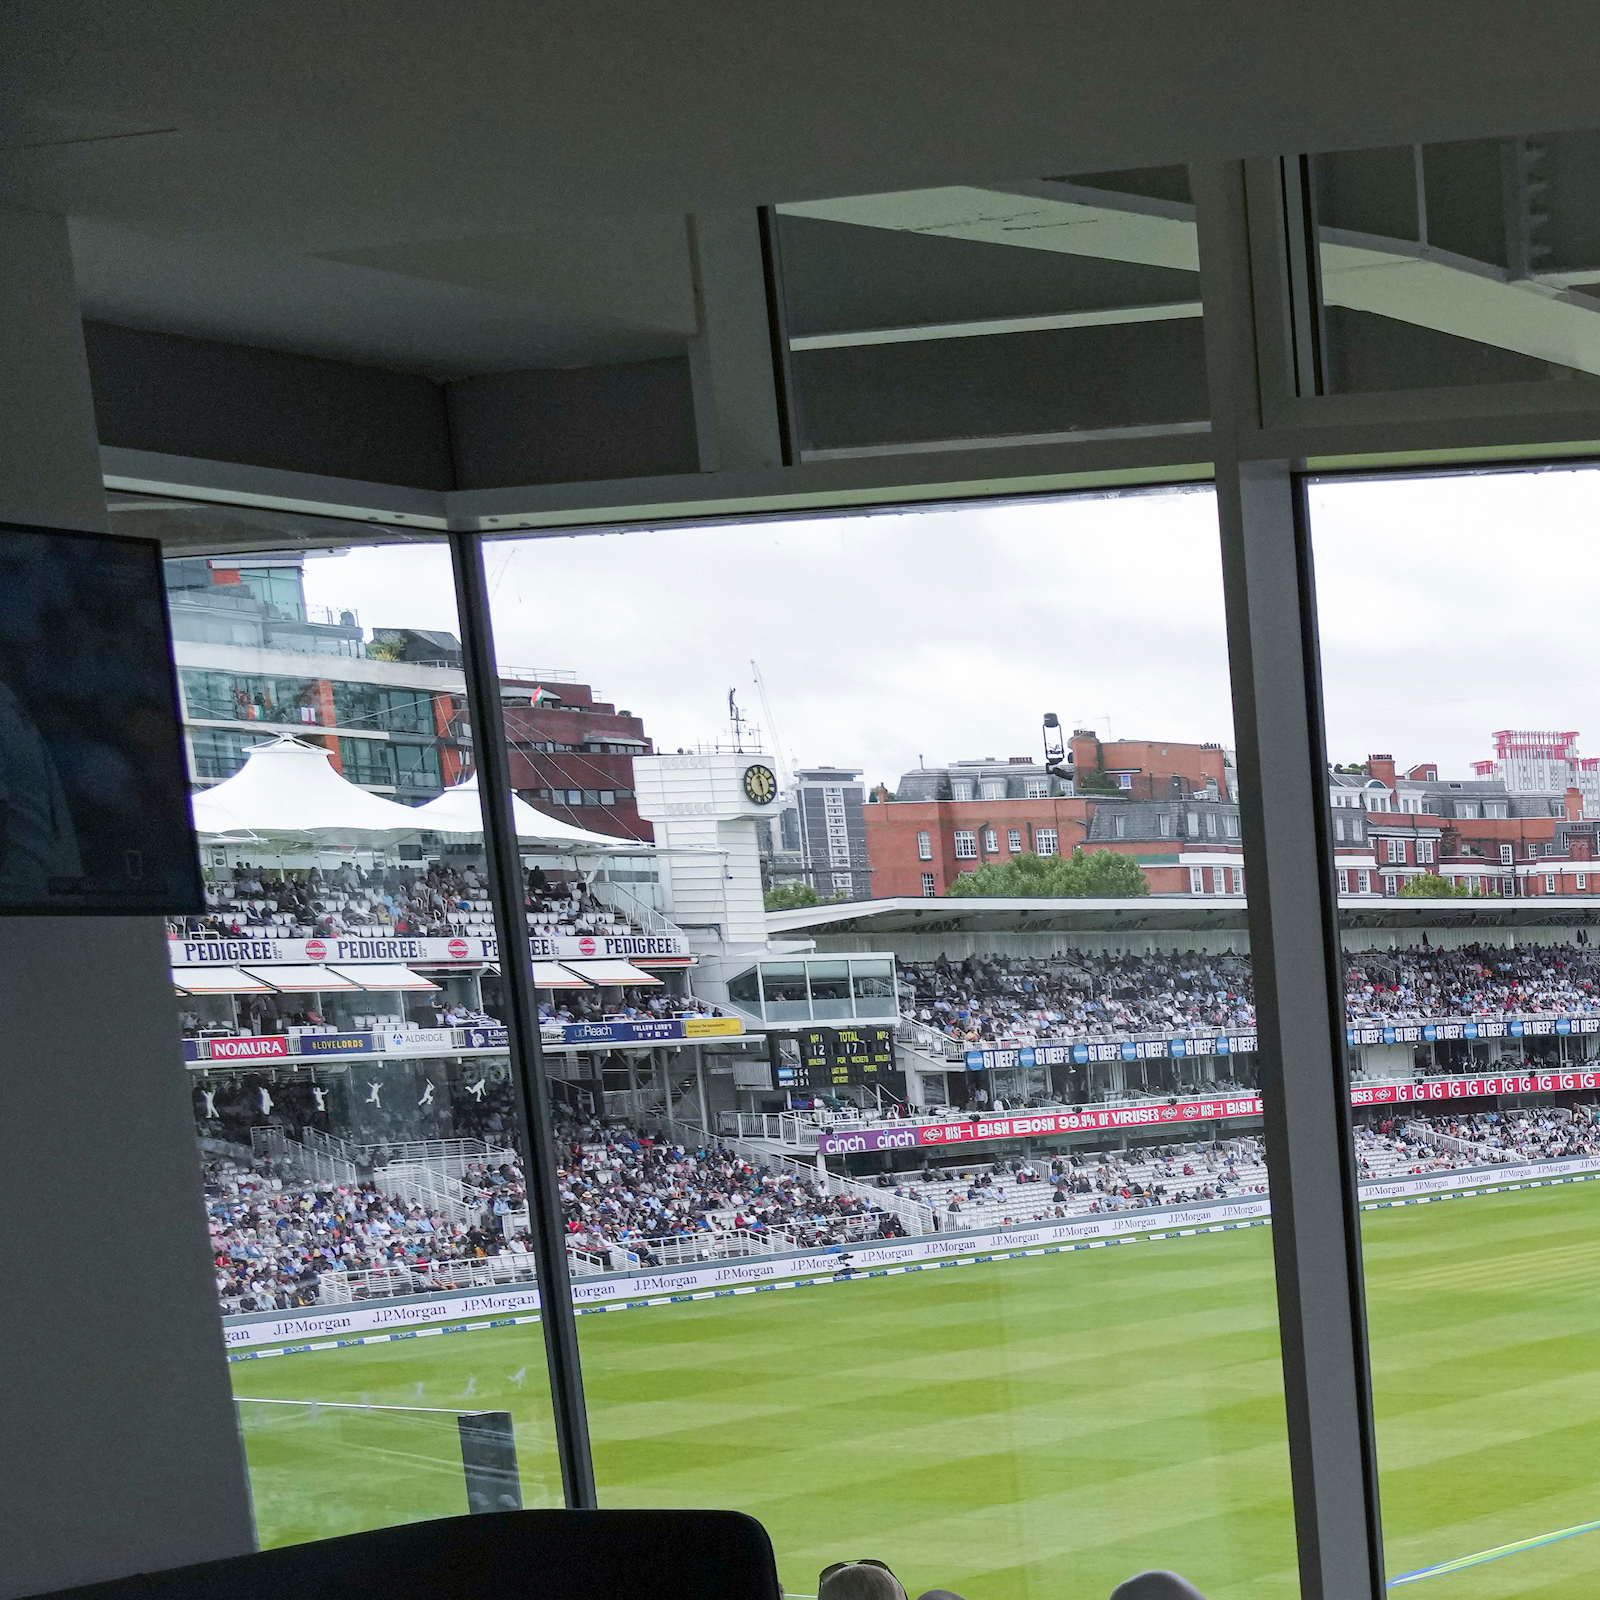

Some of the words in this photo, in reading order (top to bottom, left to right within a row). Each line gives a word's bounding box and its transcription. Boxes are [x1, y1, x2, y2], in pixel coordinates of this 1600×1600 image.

[184, 941, 272, 961] PEDIGREE
[336, 940, 418, 959] PEDIGREE
[604, 938, 672, 954] PEDIGREE
[574, 1025, 612, 1038] upReach
[632, 1023, 653, 1032] FOLLOW
[654, 1023, 672, 1031] LORD'S
[1486, 1023, 1503, 1037] DEEP
[1581, 1019, 1599, 1033] DEEP
[405, 1032, 444, 1043] ALDRIDGE
[839, 1031, 860, 1042] TOTAL
[214, 1040, 283, 1057] NOMURA
[312, 1039, 364, 1050] #LOVELORDS
[813, 1045, 825, 1055] 12
[846, 1043, 858, 1054] 17
[885, 1041, 890, 1052] 4
[996, 1051, 1015, 1067] DEEP
[1100, 1044, 1117, 1061] DEEP
[1537, 1076, 1552, 1092] IG
[1396, 1086, 1407, 1101] IG
[1226, 1100, 1253, 1114] BASH
[945, 1126, 973, 1140] BISH
[977, 1122, 1010, 1137] BASH
[1013, 1118, 1056, 1134] BOSH
[1058, 1114, 1096, 1129] 99.9%
[1099, 1112, 1110, 1126] OF
[1111, 1108, 1159, 1125] VIRUSES
[825, 1134, 866, 1153] cinch
[877, 1129, 915, 1148] cinch
[1365, 1184, 1405, 1197] J.P.Morgan
[1052, 1224, 1100, 1238] J.P.Morgan
[990, 1232, 1040, 1247] J.P.Morgan
[924, 1240, 976, 1255] J.P.Morgan
[861, 1249, 913, 1263] J.P.Morgan
[715, 1265, 774, 1281] J.P.Morgan
[633, 1273, 698, 1292] J.P.Morgan
[461, 1294, 535, 1312] J.P.Morgan
[372, 1304, 447, 1324] J.P.Morgan
[273, 1316, 351, 1336] J.P.Morgan
